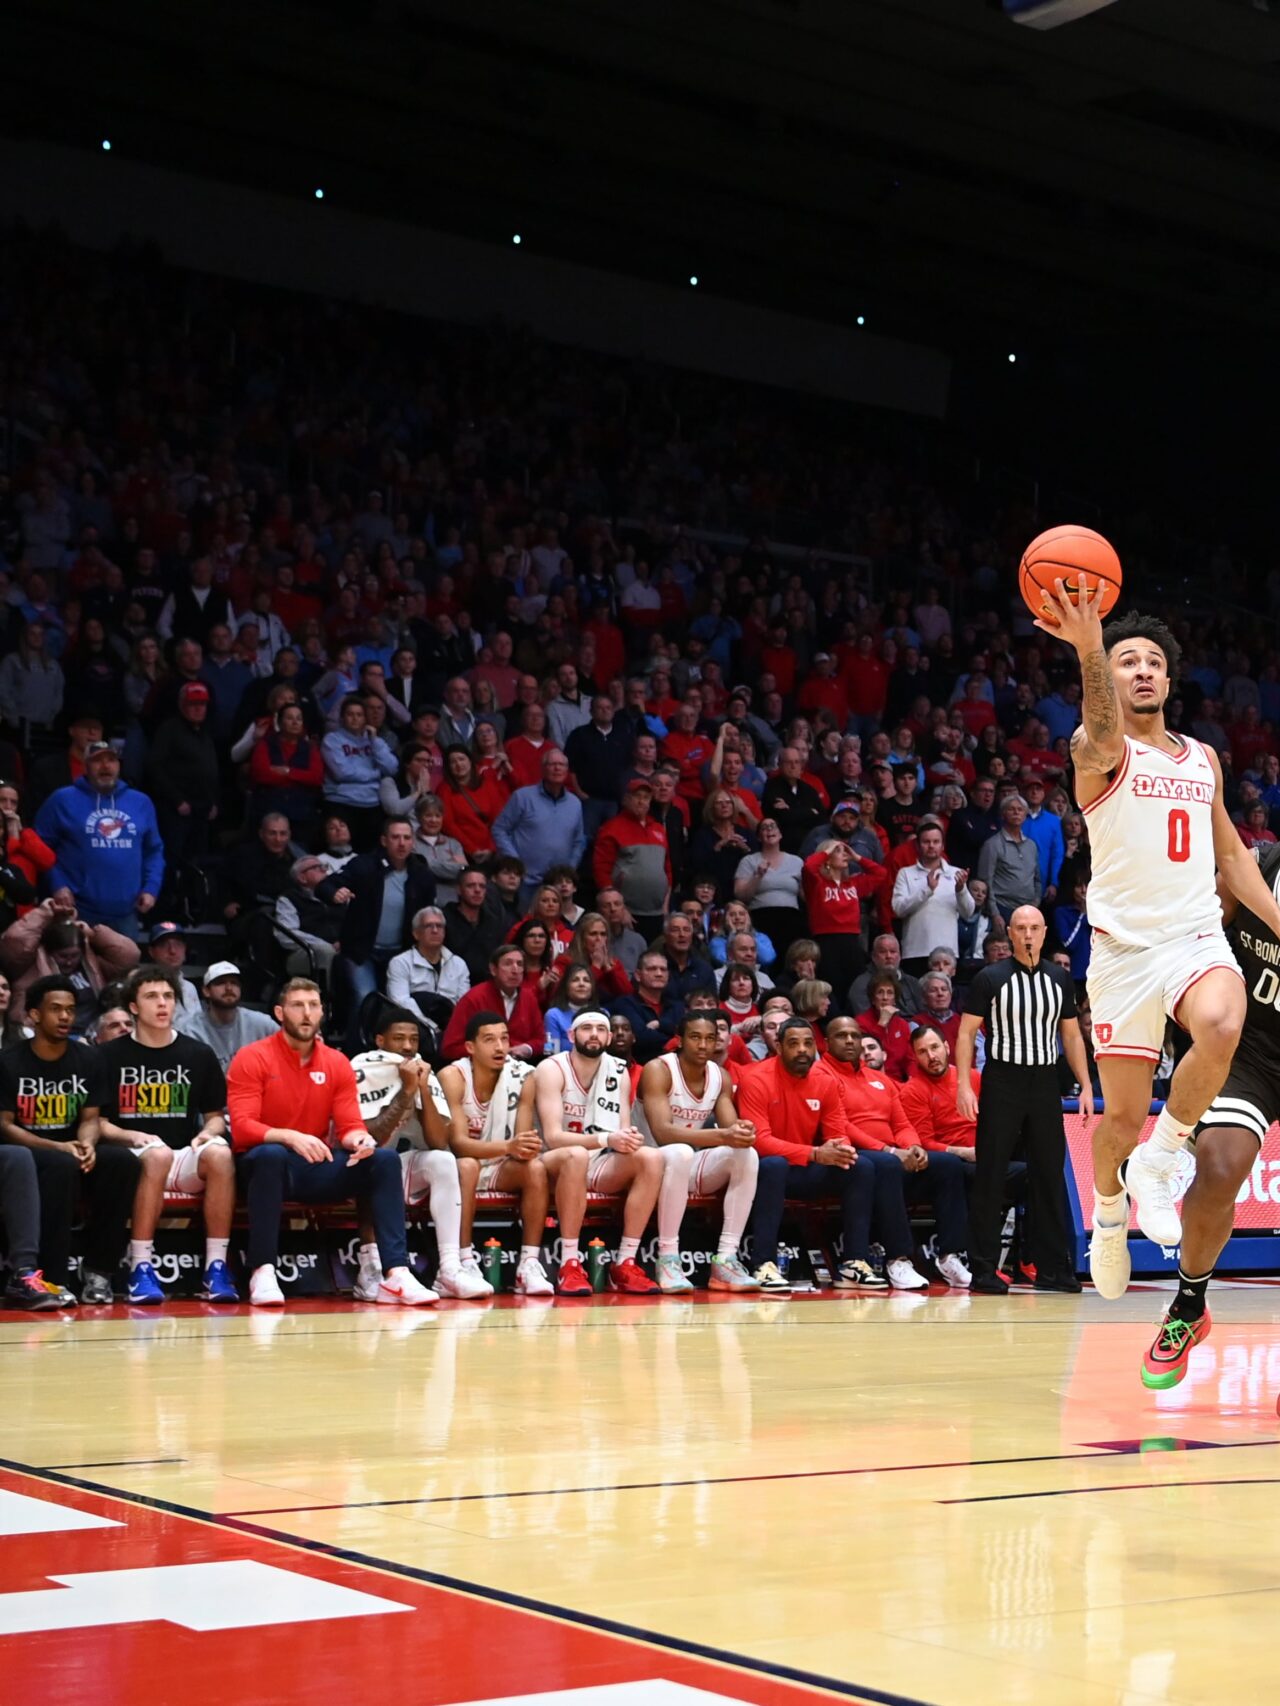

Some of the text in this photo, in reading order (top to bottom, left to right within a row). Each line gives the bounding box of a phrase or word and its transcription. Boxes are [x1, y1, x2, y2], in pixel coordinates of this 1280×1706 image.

[1132, 773, 1214, 806] DAYTON
[91, 837, 133, 849] DAYTON
[1167, 808, 1191, 863] 0
[17, 1073, 89, 1096] Black
[119, 1064, 192, 1086] Black
[16, 1093, 89, 1120] HISTORY
[119, 1084, 192, 1109] HISTORY
